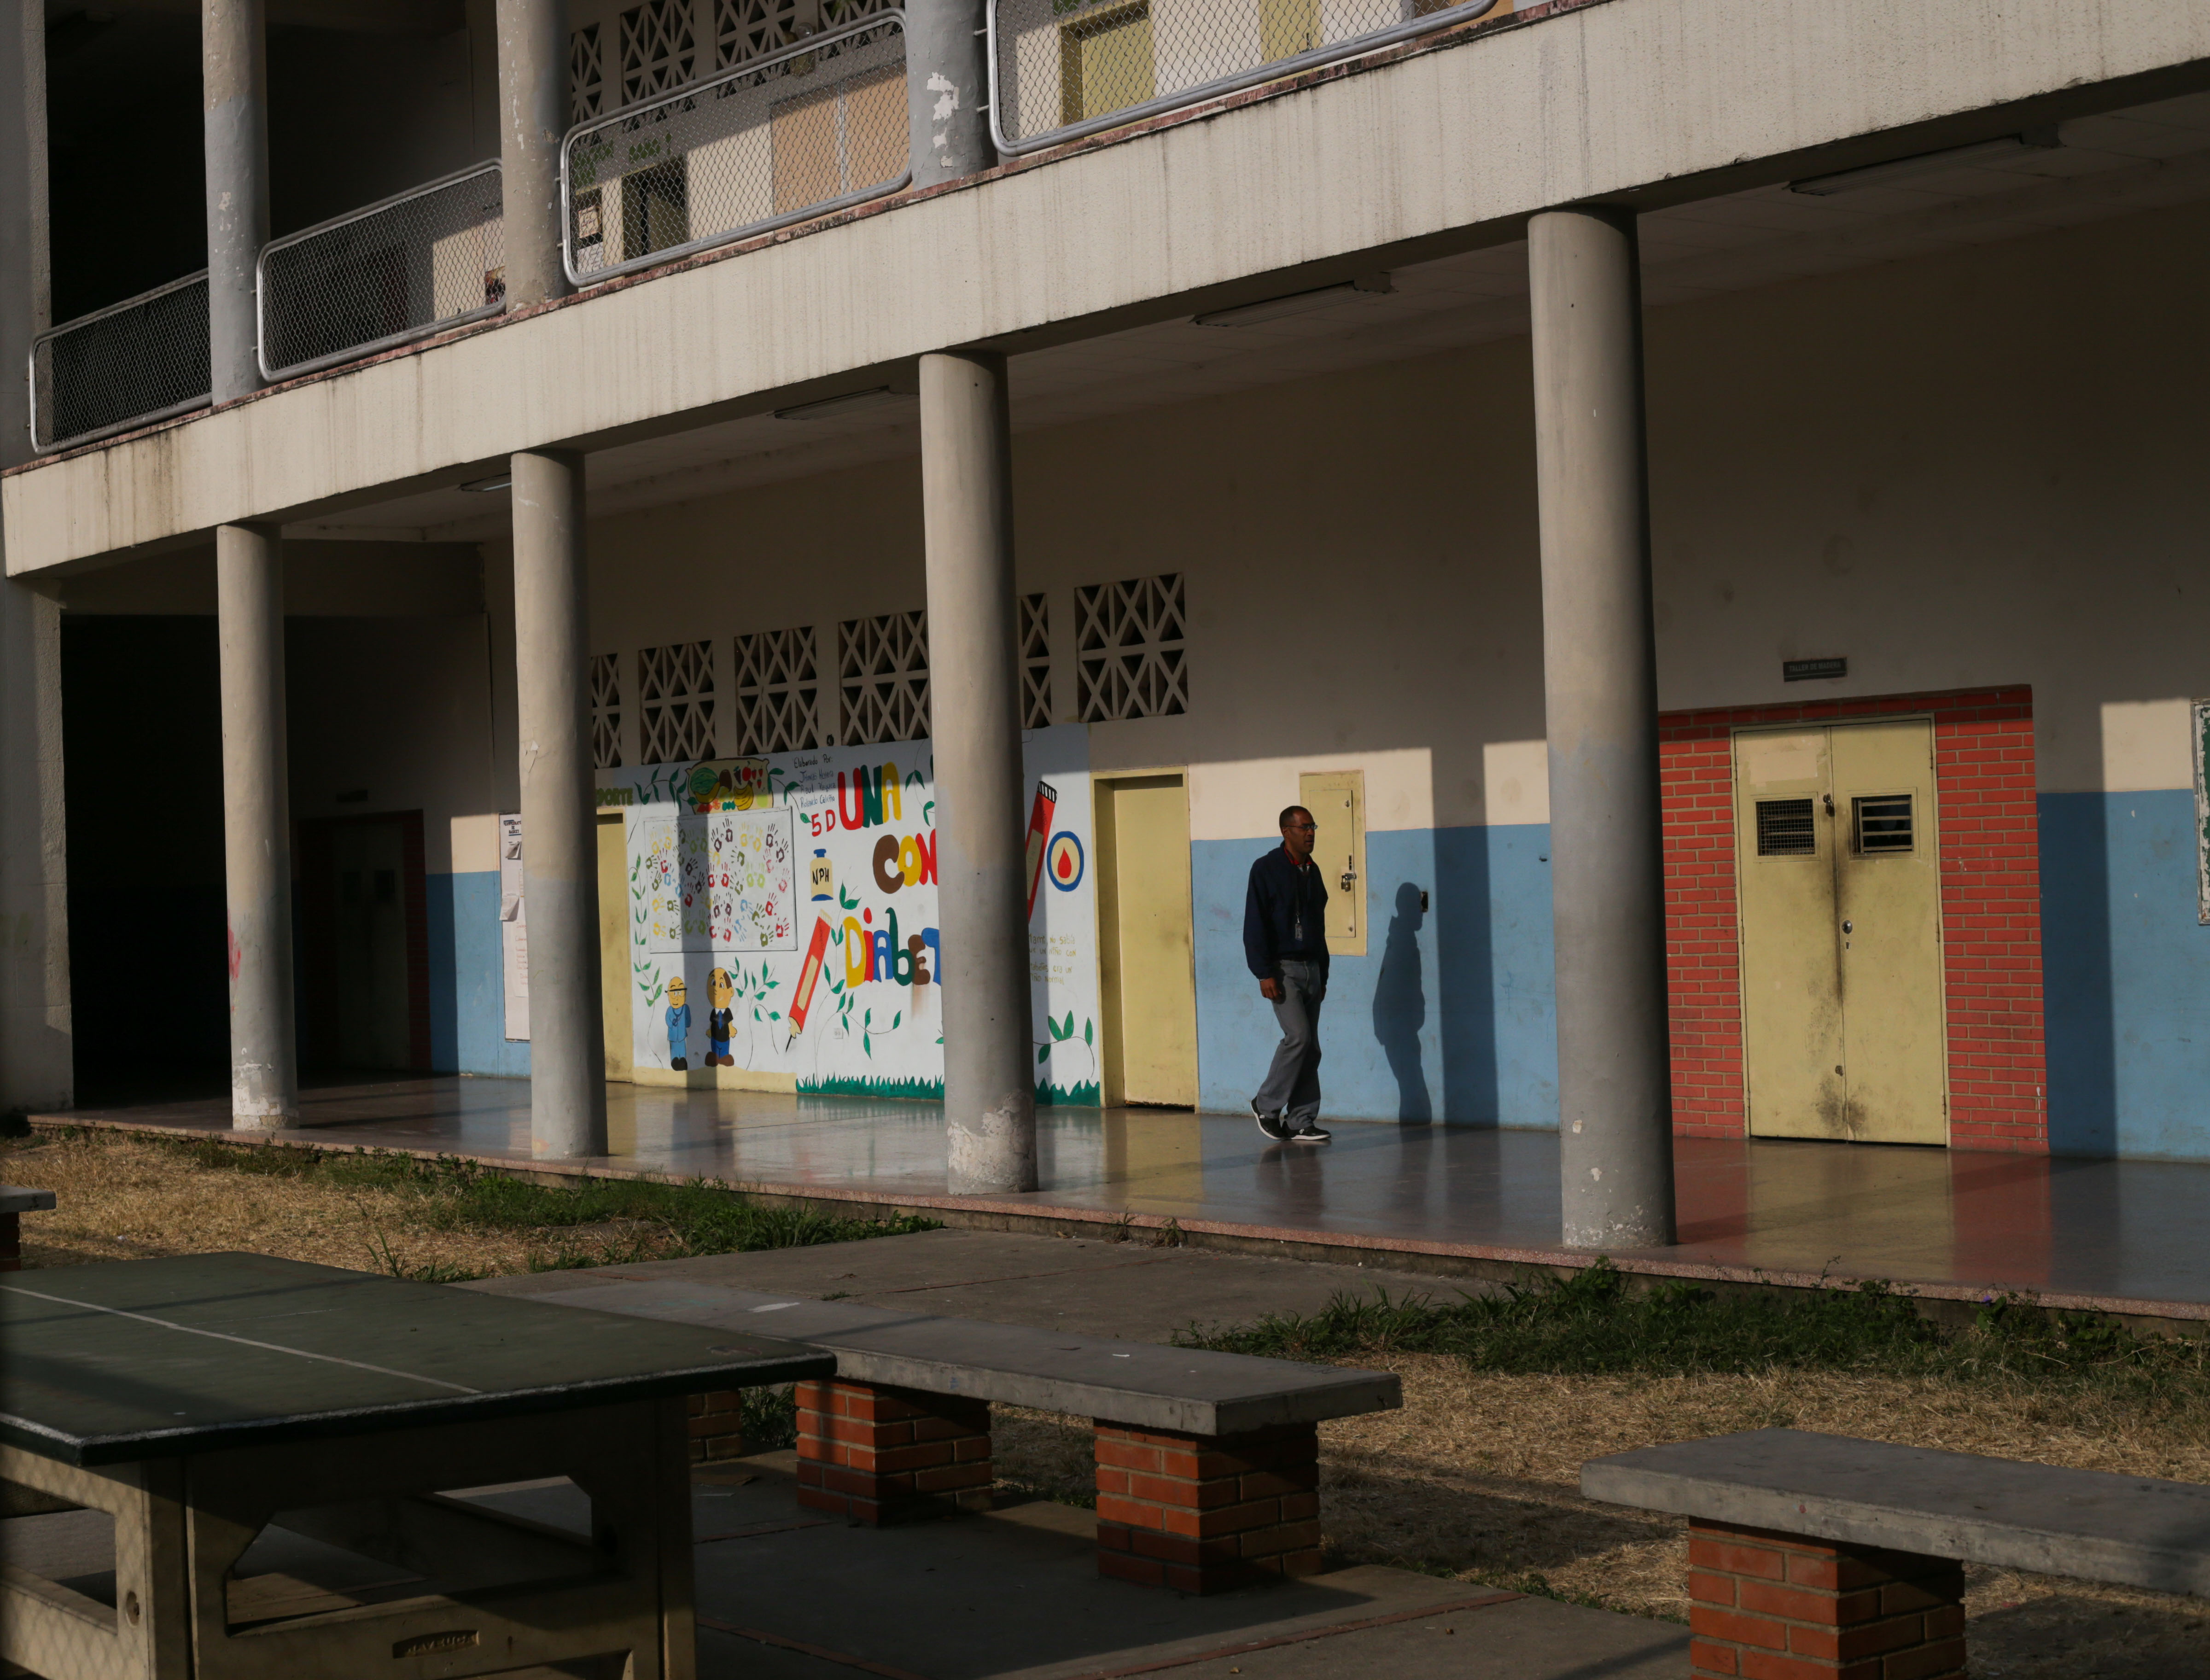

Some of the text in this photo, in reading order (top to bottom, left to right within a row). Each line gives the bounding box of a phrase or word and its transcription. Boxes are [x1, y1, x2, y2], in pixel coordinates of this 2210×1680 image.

[794, 756, 818, 768] Elaborado
[838, 762, 902, 830] UNA
[812, 868, 829, 885] NPH
[873, 828, 938, 893] CON
